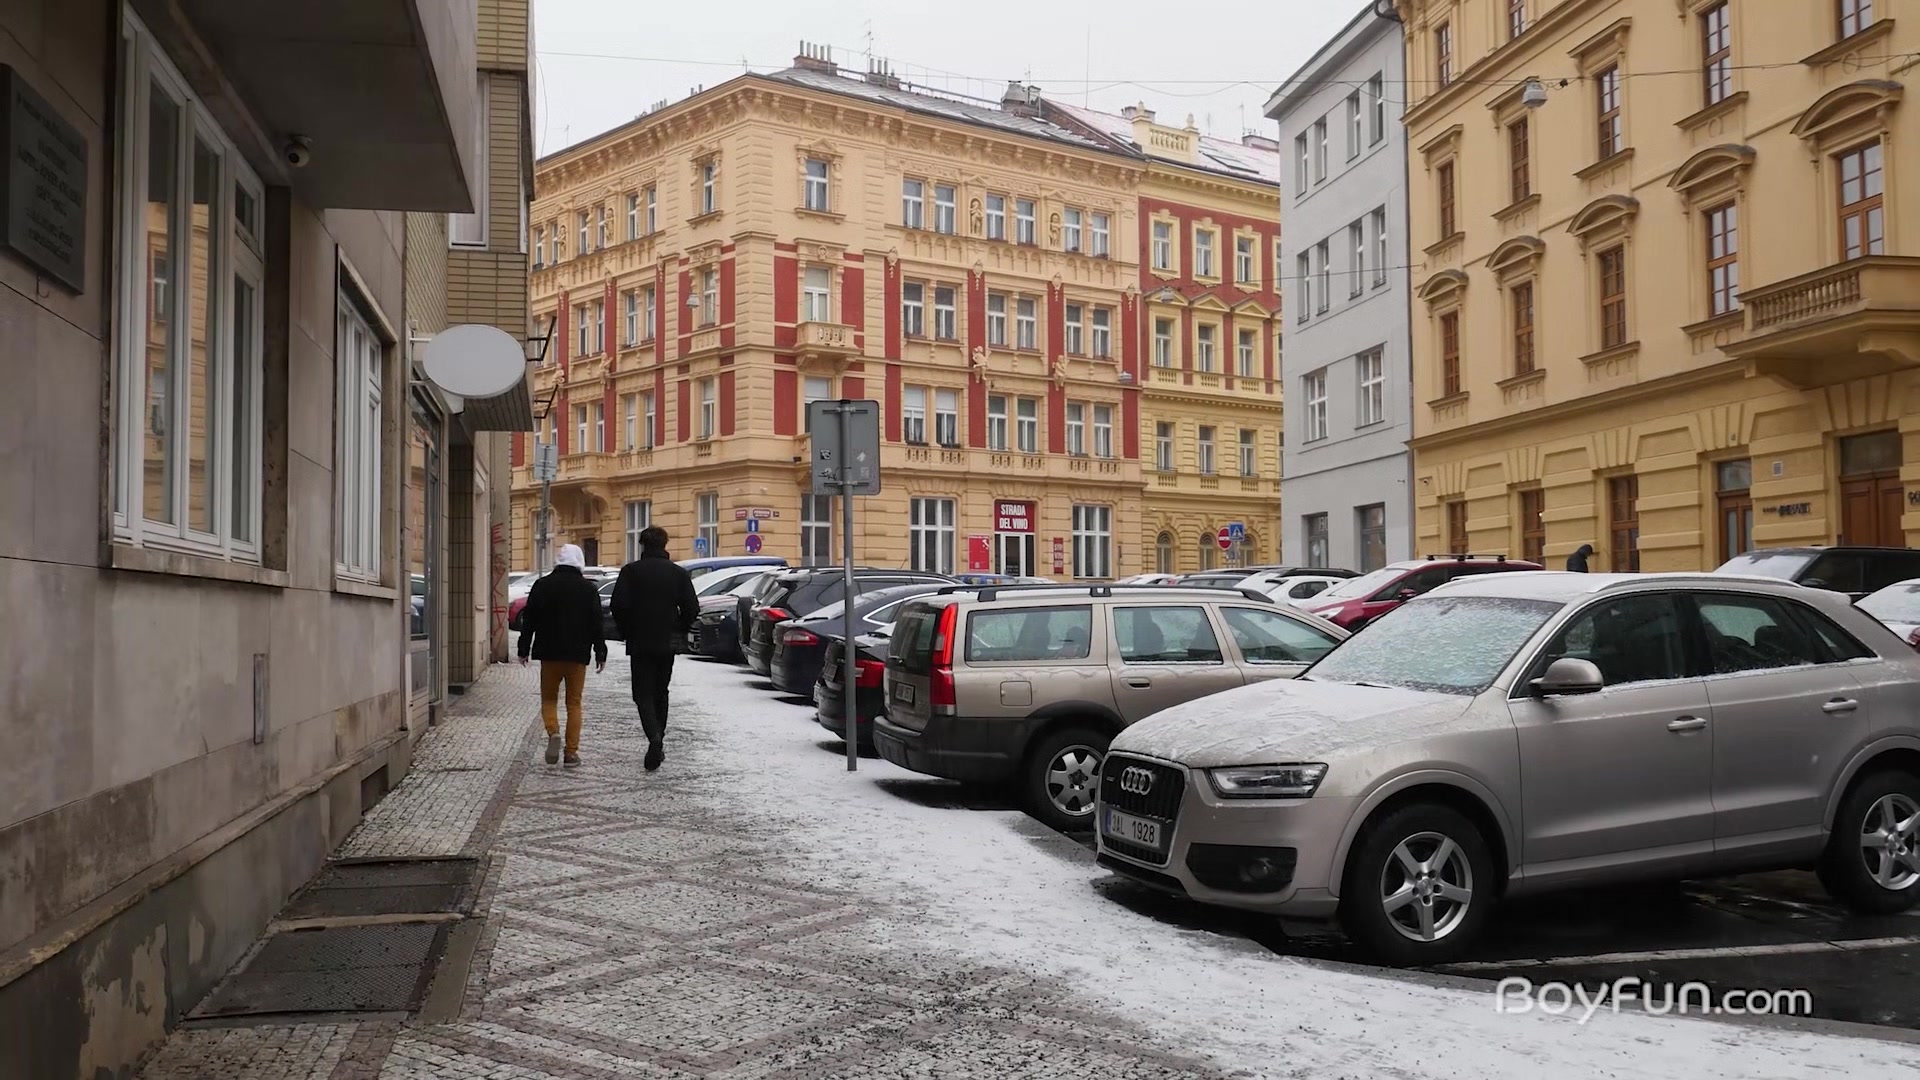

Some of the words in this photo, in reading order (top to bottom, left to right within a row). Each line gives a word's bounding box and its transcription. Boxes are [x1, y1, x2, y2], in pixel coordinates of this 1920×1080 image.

[1000, 504, 1026, 515] STRADA
[999, 517, 1012, 529] DEL
[1012, 517, 1028, 530] VINO
[1132, 821, 1155, 843] 1928
